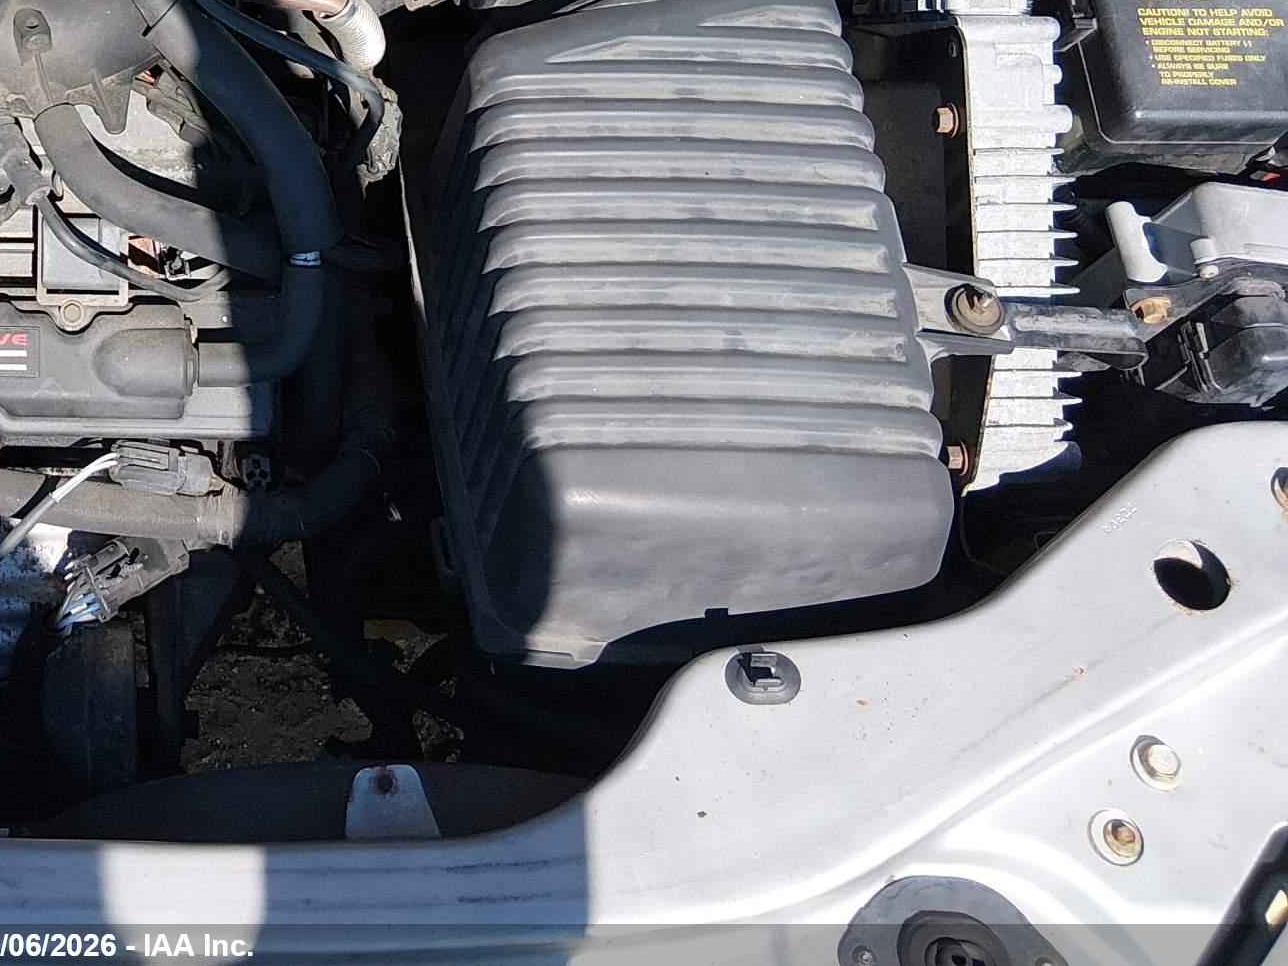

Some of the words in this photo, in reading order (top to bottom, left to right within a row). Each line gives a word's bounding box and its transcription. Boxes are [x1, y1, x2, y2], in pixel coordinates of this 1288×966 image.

[1137, 8, 1190, 17] CAUTION!
[1192, 8, 1207, 17] TO
[1210, 8, 1238, 17] HELP
[1240, 8, 1273, 17] AVOID
[1139, 17, 1186, 27] VEHICLE
[1188, 18, 1235, 27] DAMAGE
[1238, 18, 1285, 27] AND/OR
[1142, 27, 1185, 36] ENGINE
[1187, 27, 1210, 36] NOT
[1212, 28, 1270, 37] STARTING:
[1151, 39, 1203, 47] DISCONNECT
